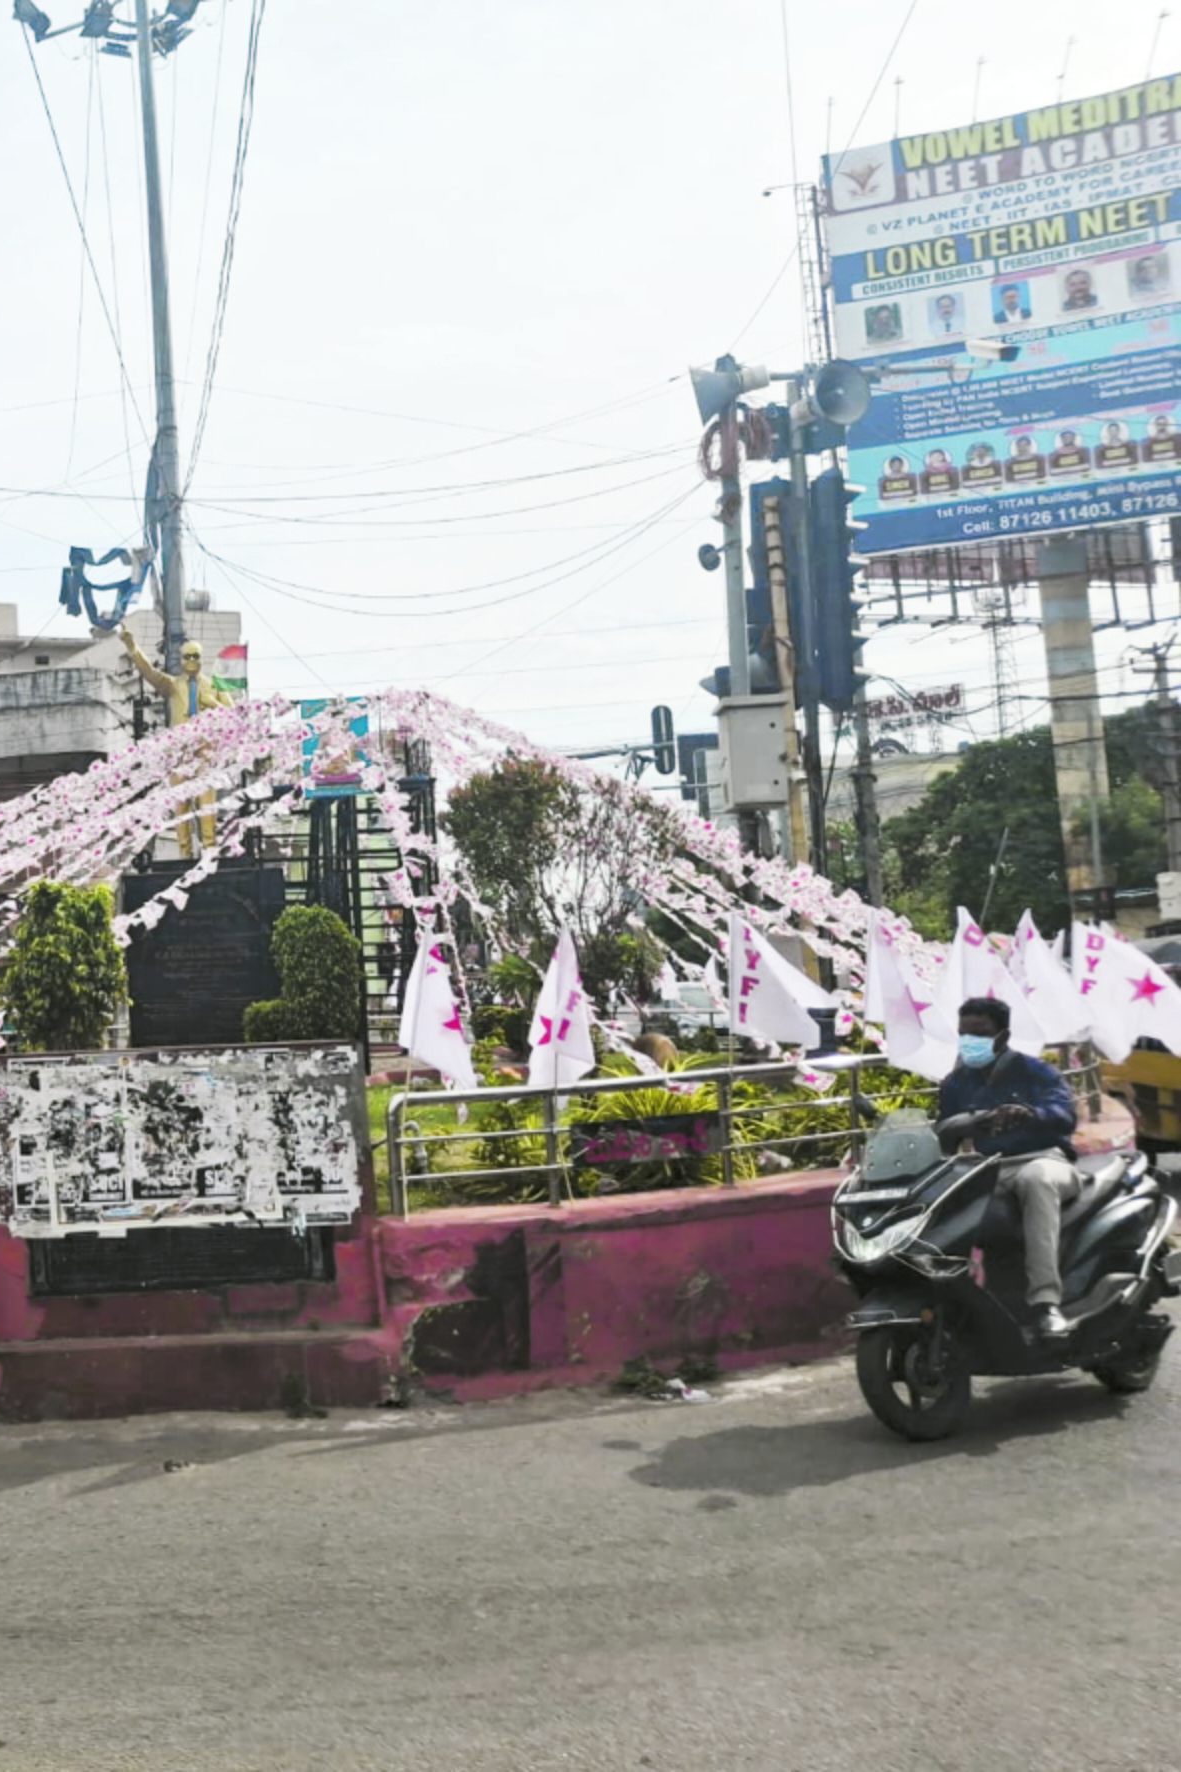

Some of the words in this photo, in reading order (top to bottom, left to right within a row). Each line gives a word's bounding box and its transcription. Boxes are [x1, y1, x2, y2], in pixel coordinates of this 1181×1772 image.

[900, 117, 1021, 169] VOWEL
[905, 154, 1003, 201] NEET
[1020, 111, 1181, 178] ACADE
[978, 182, 1027, 200] WORD
[1035, 175, 1056, 188] TO
[1061, 163, 1113, 182] WORD
[882, 219, 903, 231] VZ
[907, 206, 969, 227] PLANET
[991, 185, 1072, 211] ACADEMY
[1079, 176, 1113, 192] FOR
[949, 215, 991, 231] NEET
[1007, 207, 1028, 220] IIT
[1044, 199, 1072, 214] IAS
[866, 235, 957, 280] LONG
[966, 214, 1067, 261] TERM
[1077, 191, 1173, 239] NEET
[1003, 246, 1070, 270] PERSISTENT
[862, 273, 931, 296] CONSISTENT
[934, 264, 984, 283] RESULTS
[936, 507, 954, 519] 1st
[998, 495, 1035, 511] TITAN
[999, 510, 1053, 530] 87126
[1121, 493, 1178, 513] 87126
